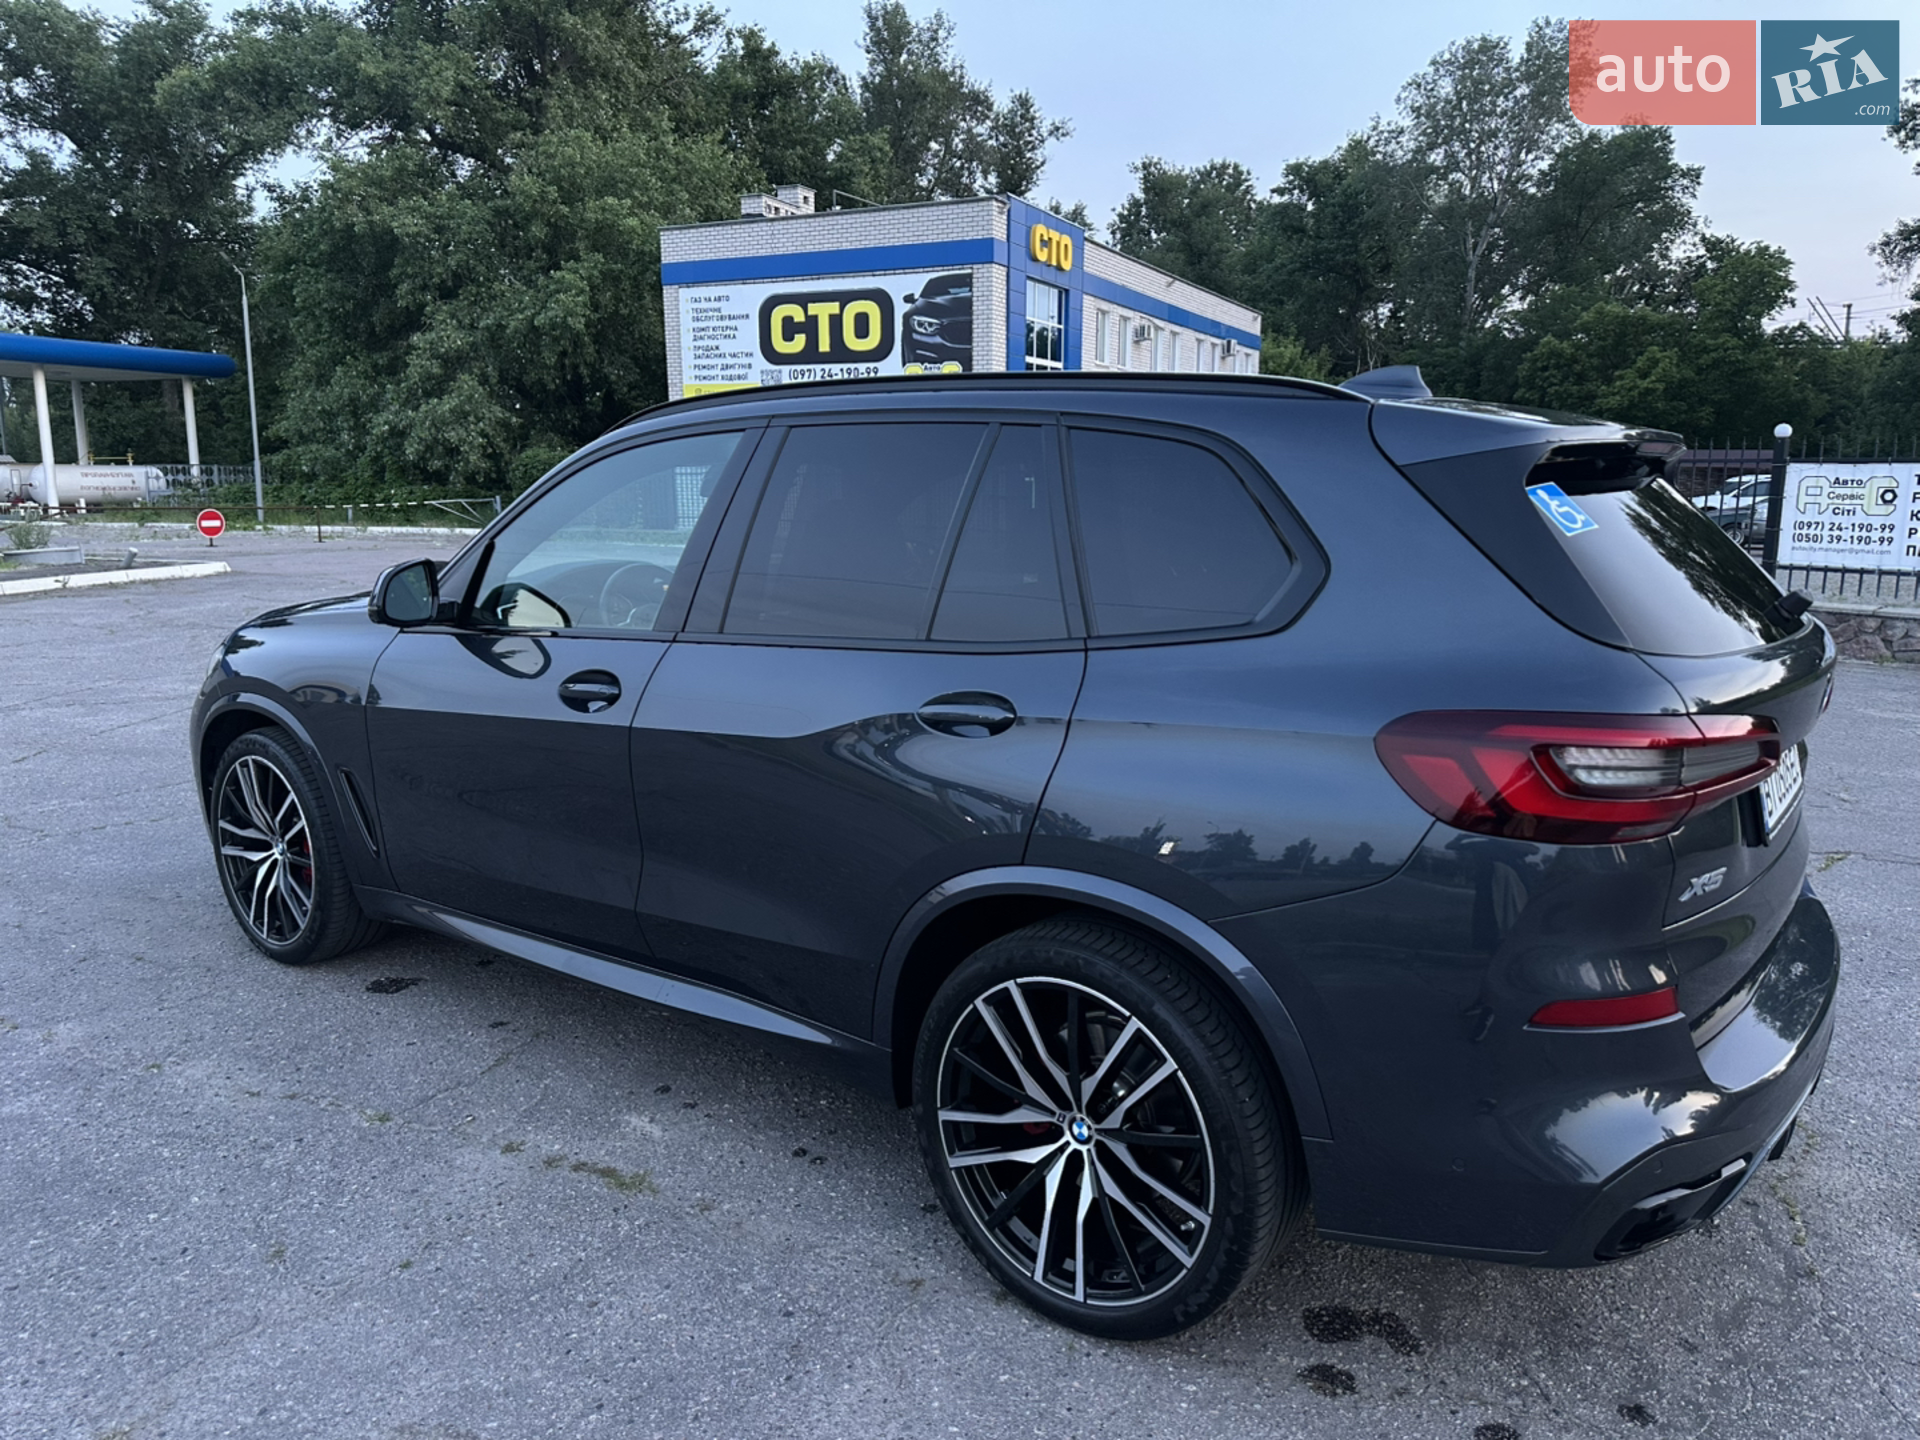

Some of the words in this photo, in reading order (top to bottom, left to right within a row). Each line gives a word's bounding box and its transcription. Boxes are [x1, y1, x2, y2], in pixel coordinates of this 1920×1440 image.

[1030, 223, 1073, 272] СТО
[713, 294, 730, 303] АВТО
[770, 299, 882, 355] СТО
[788, 367, 817, 381] (097)
[820, 366, 879, 380] 24-190-99
[1832, 477, 1864, 486] Авто
[1827, 491, 1866, 501] Сервіс
[1832, 506, 1857, 517] Сіті
[1792, 520, 1825, 532] (097)
[1828, 522, 1896, 534] 24-190-99
[1791, 532, 1824, 545] (050)
[1827, 534, 1894, 546] 39-190-99
[1678, 866, 1728, 902] X5
